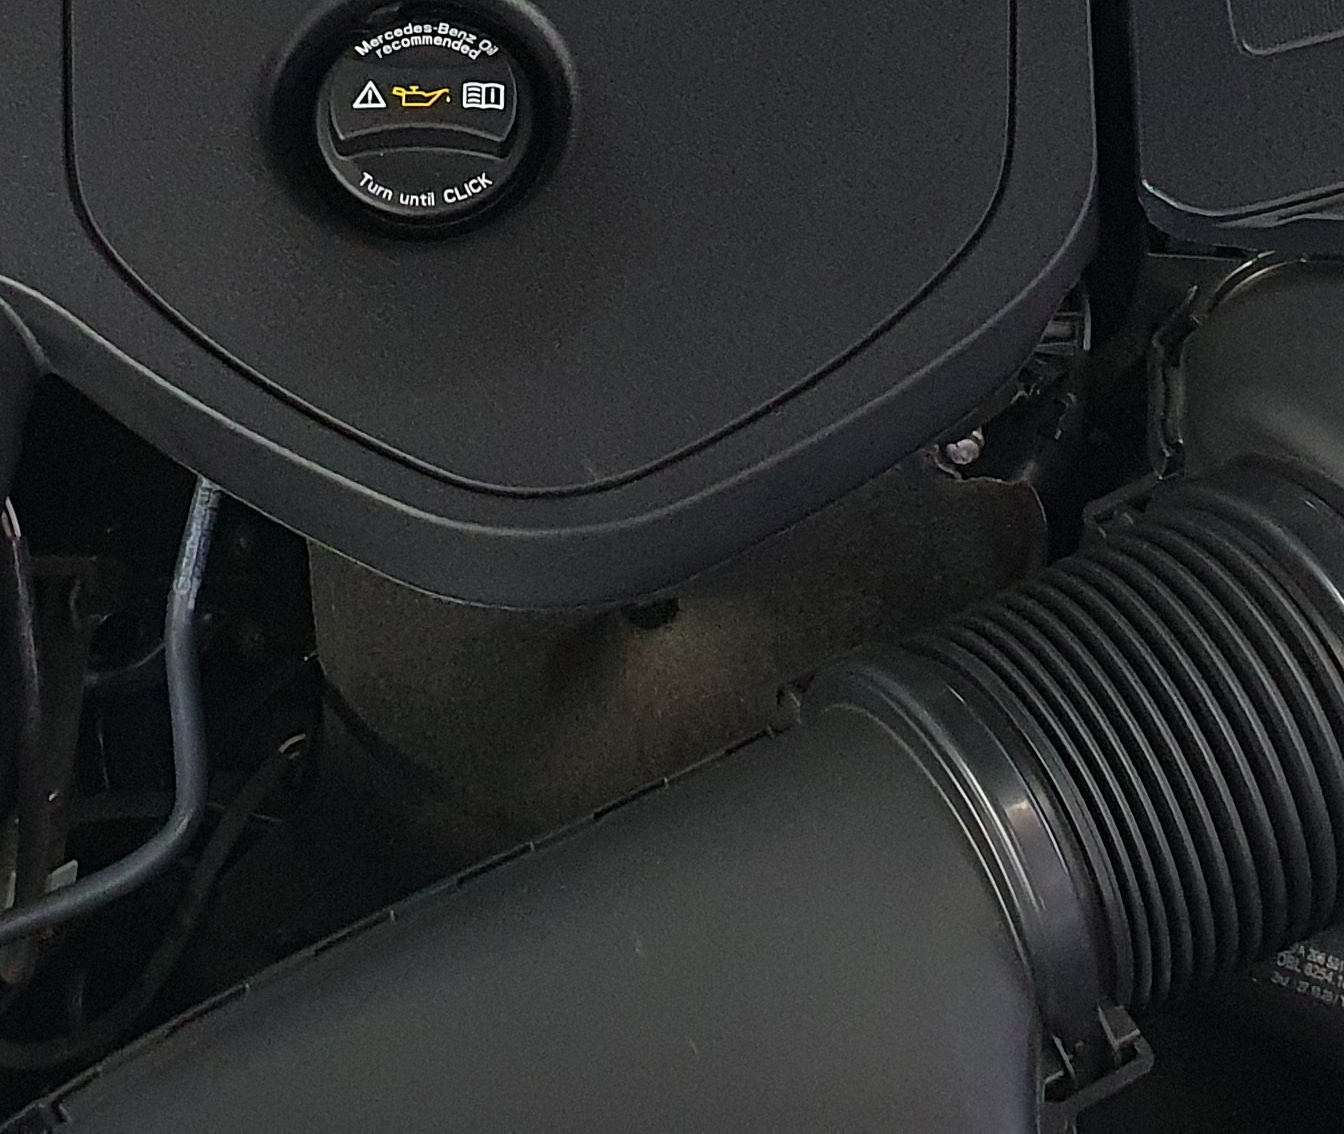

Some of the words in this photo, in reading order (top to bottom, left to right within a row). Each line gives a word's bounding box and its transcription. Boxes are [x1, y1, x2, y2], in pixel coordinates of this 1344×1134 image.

[354, 22, 478, 57] Mercedes-Benz
[479, 38, 500, 57] Oil
[375, 35, 481, 60] recommended
[359, 171, 393, 201] Turn
[399, 191, 436, 206] until
[443, 172, 493, 203] CLICK
